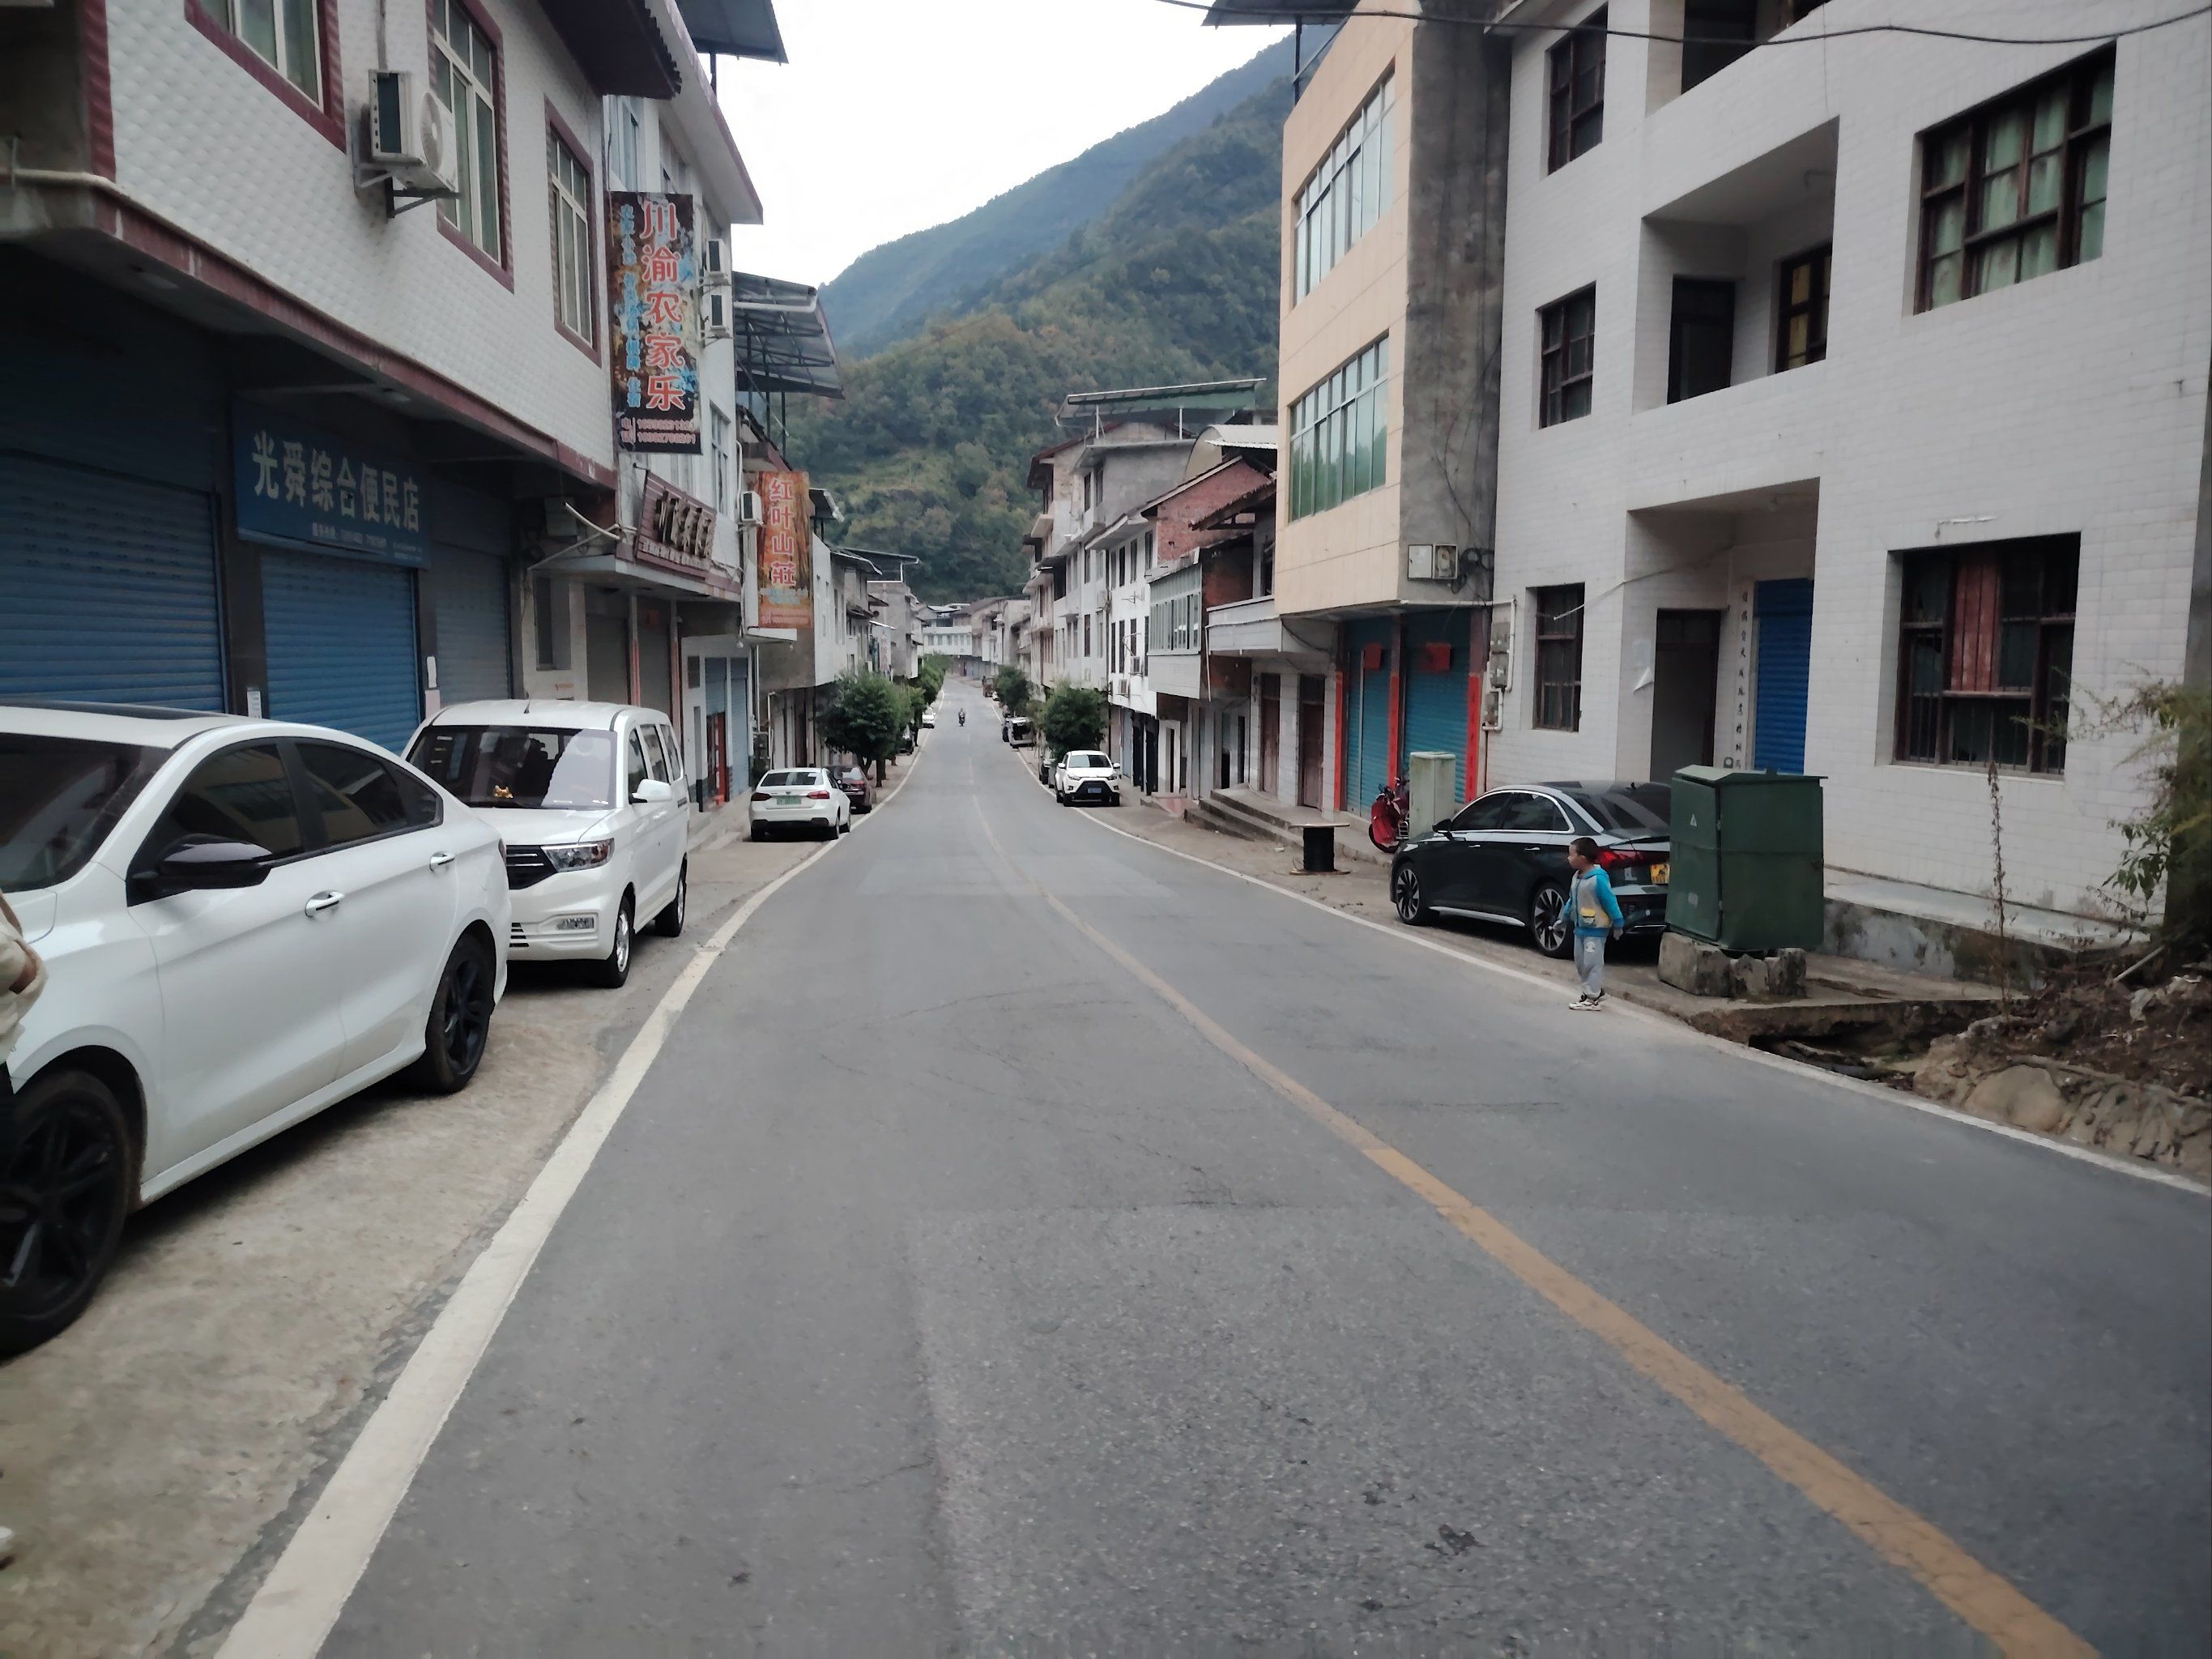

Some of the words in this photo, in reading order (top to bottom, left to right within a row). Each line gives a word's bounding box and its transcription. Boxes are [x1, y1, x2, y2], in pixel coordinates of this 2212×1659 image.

[640, 202, 686, 411] 川渝农家乐
[252, 430, 420, 533] 光舜综合便民店
